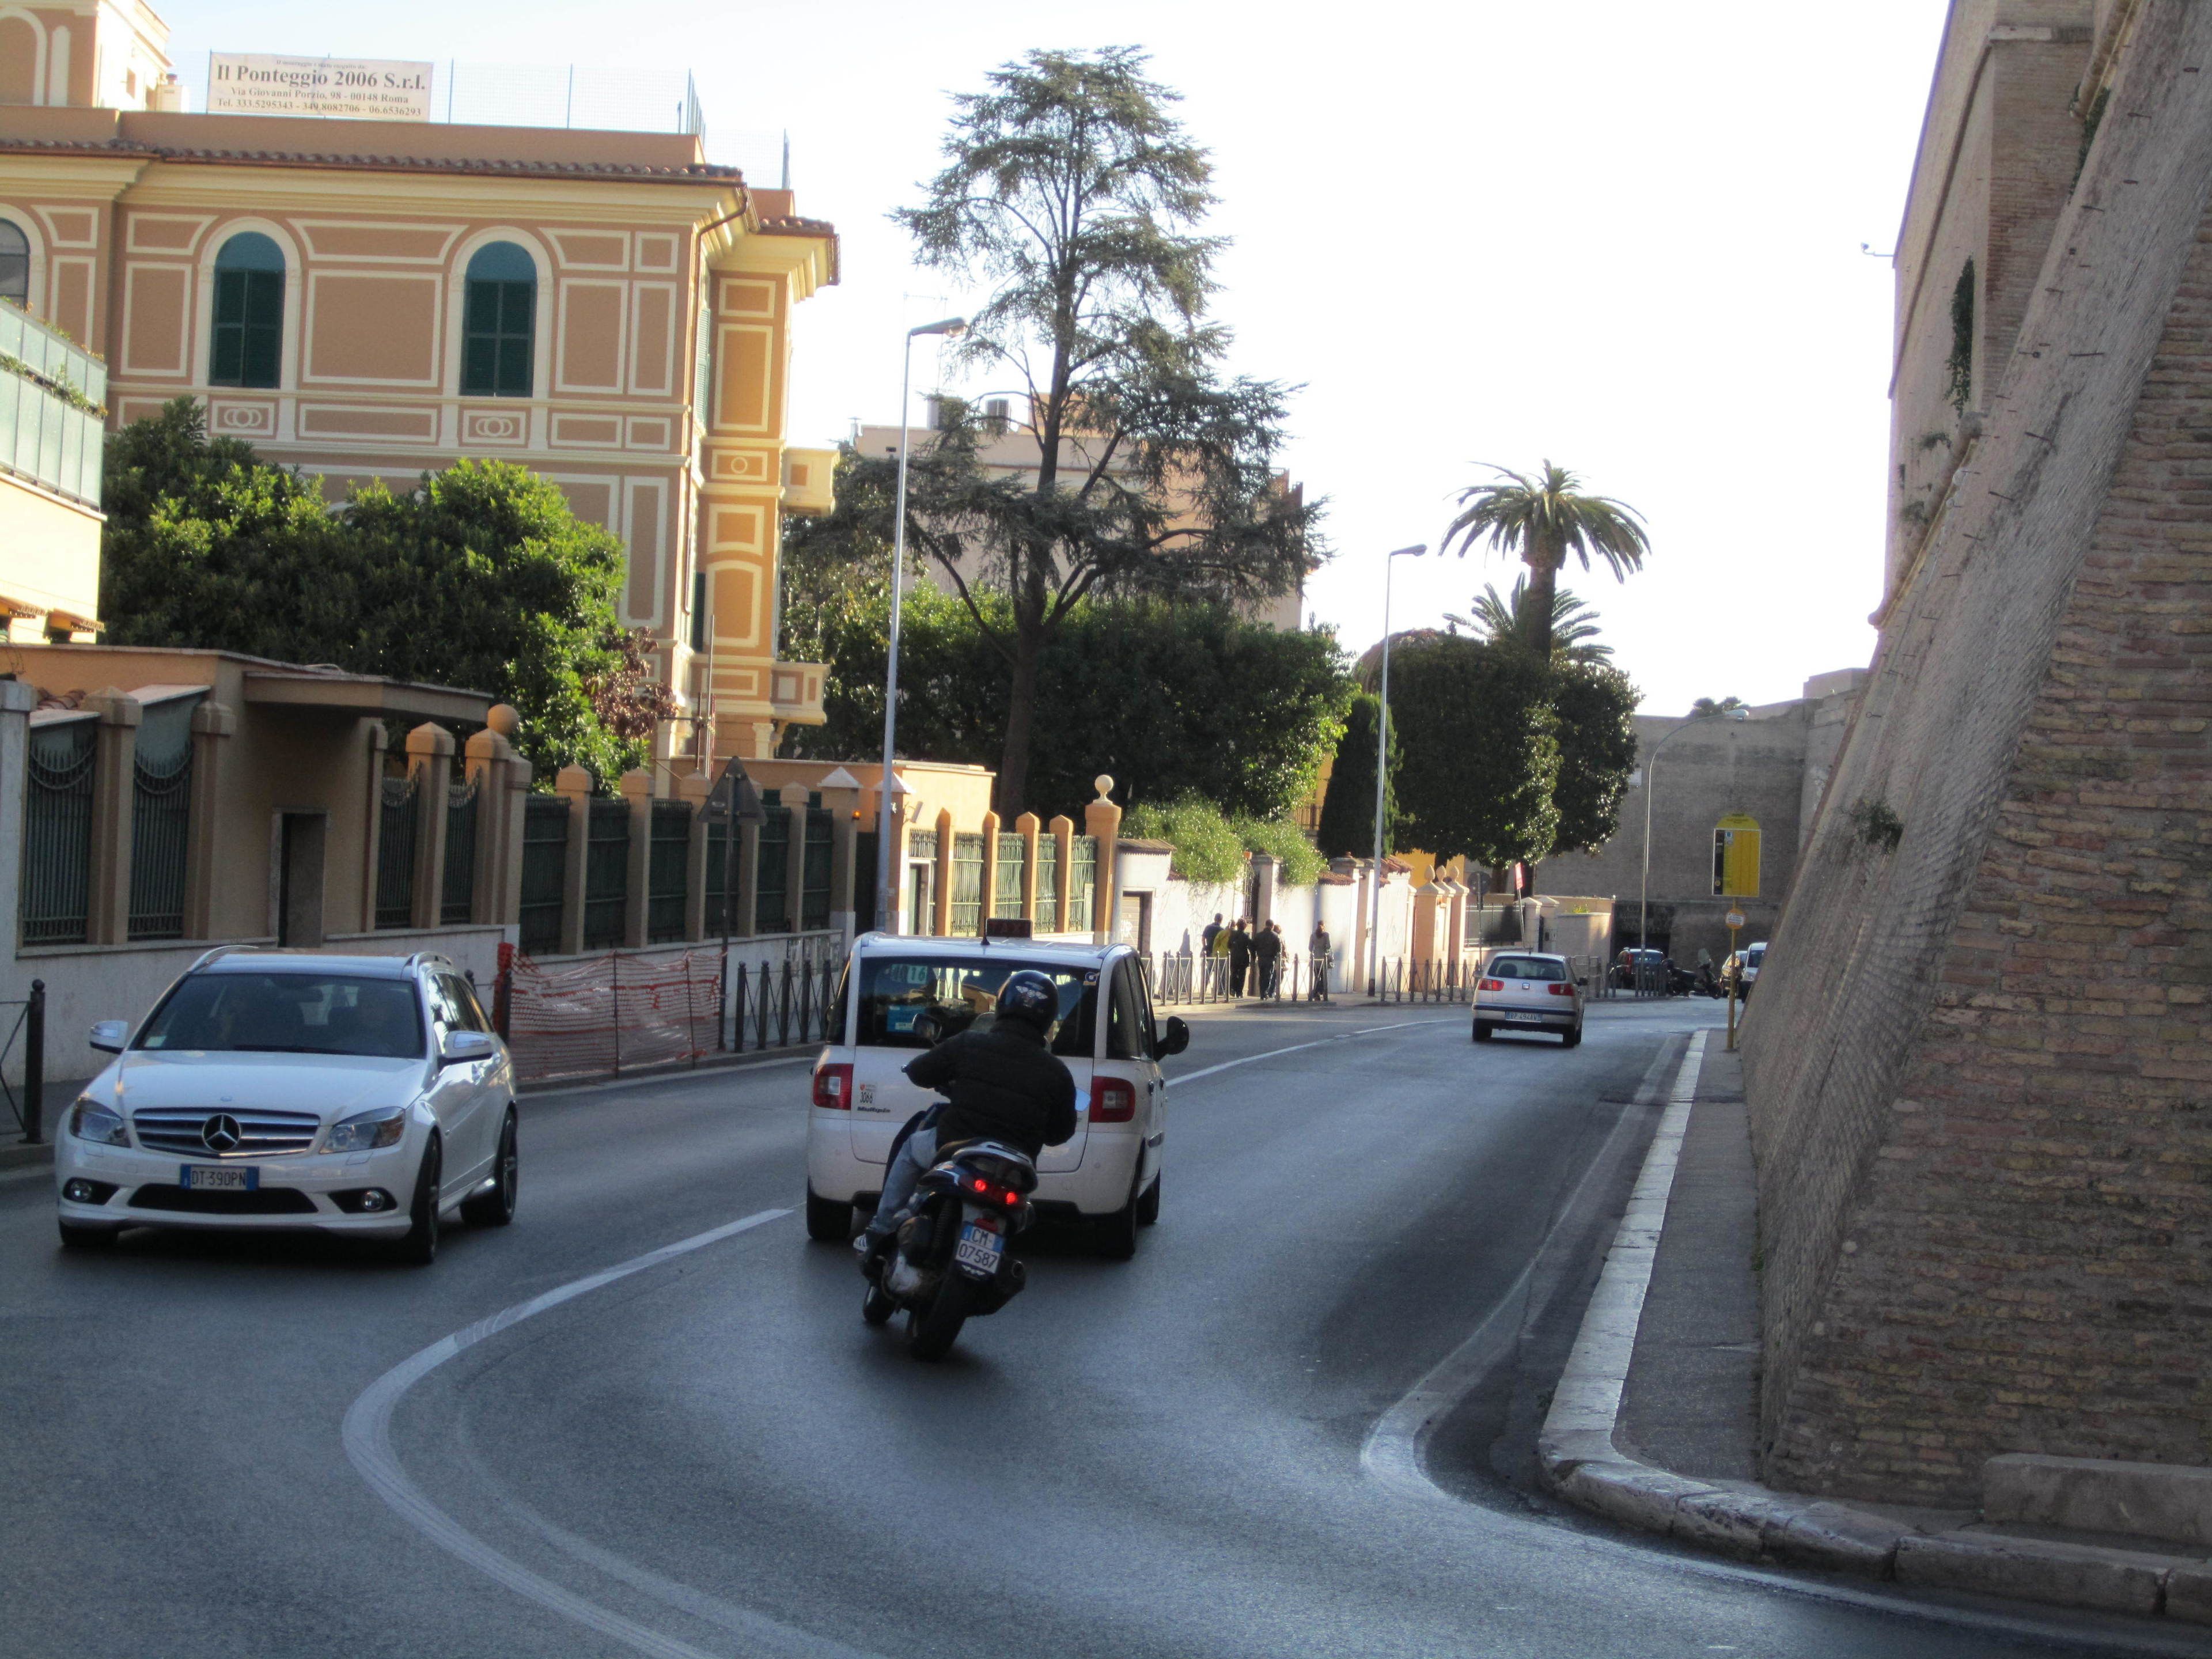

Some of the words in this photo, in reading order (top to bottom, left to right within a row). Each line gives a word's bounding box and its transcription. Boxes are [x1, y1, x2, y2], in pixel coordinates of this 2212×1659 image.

[218, 65, 229, 79] Il
[237, 65, 328, 88] Ponteggio
[335, 71, 377, 86] 2006
[384, 73, 425, 89] S.r.l.
[232, 87, 245, 95] Via
[249, 88, 291, 97] Giovanni
[294, 90, 327, 100] Porzio,
[350, 92, 378, 101] 00148
[381, 94, 408, 103] Roma
[217, 99, 233, 107] Tel.
[237, 99, 293, 109] 333.5295343
[191, 1171, 204, 1185] DT
[208, 1172, 245, 1185] 390PN
[972, 1228, 988, 1246] CM
[959, 1244, 997, 1268] 07587
